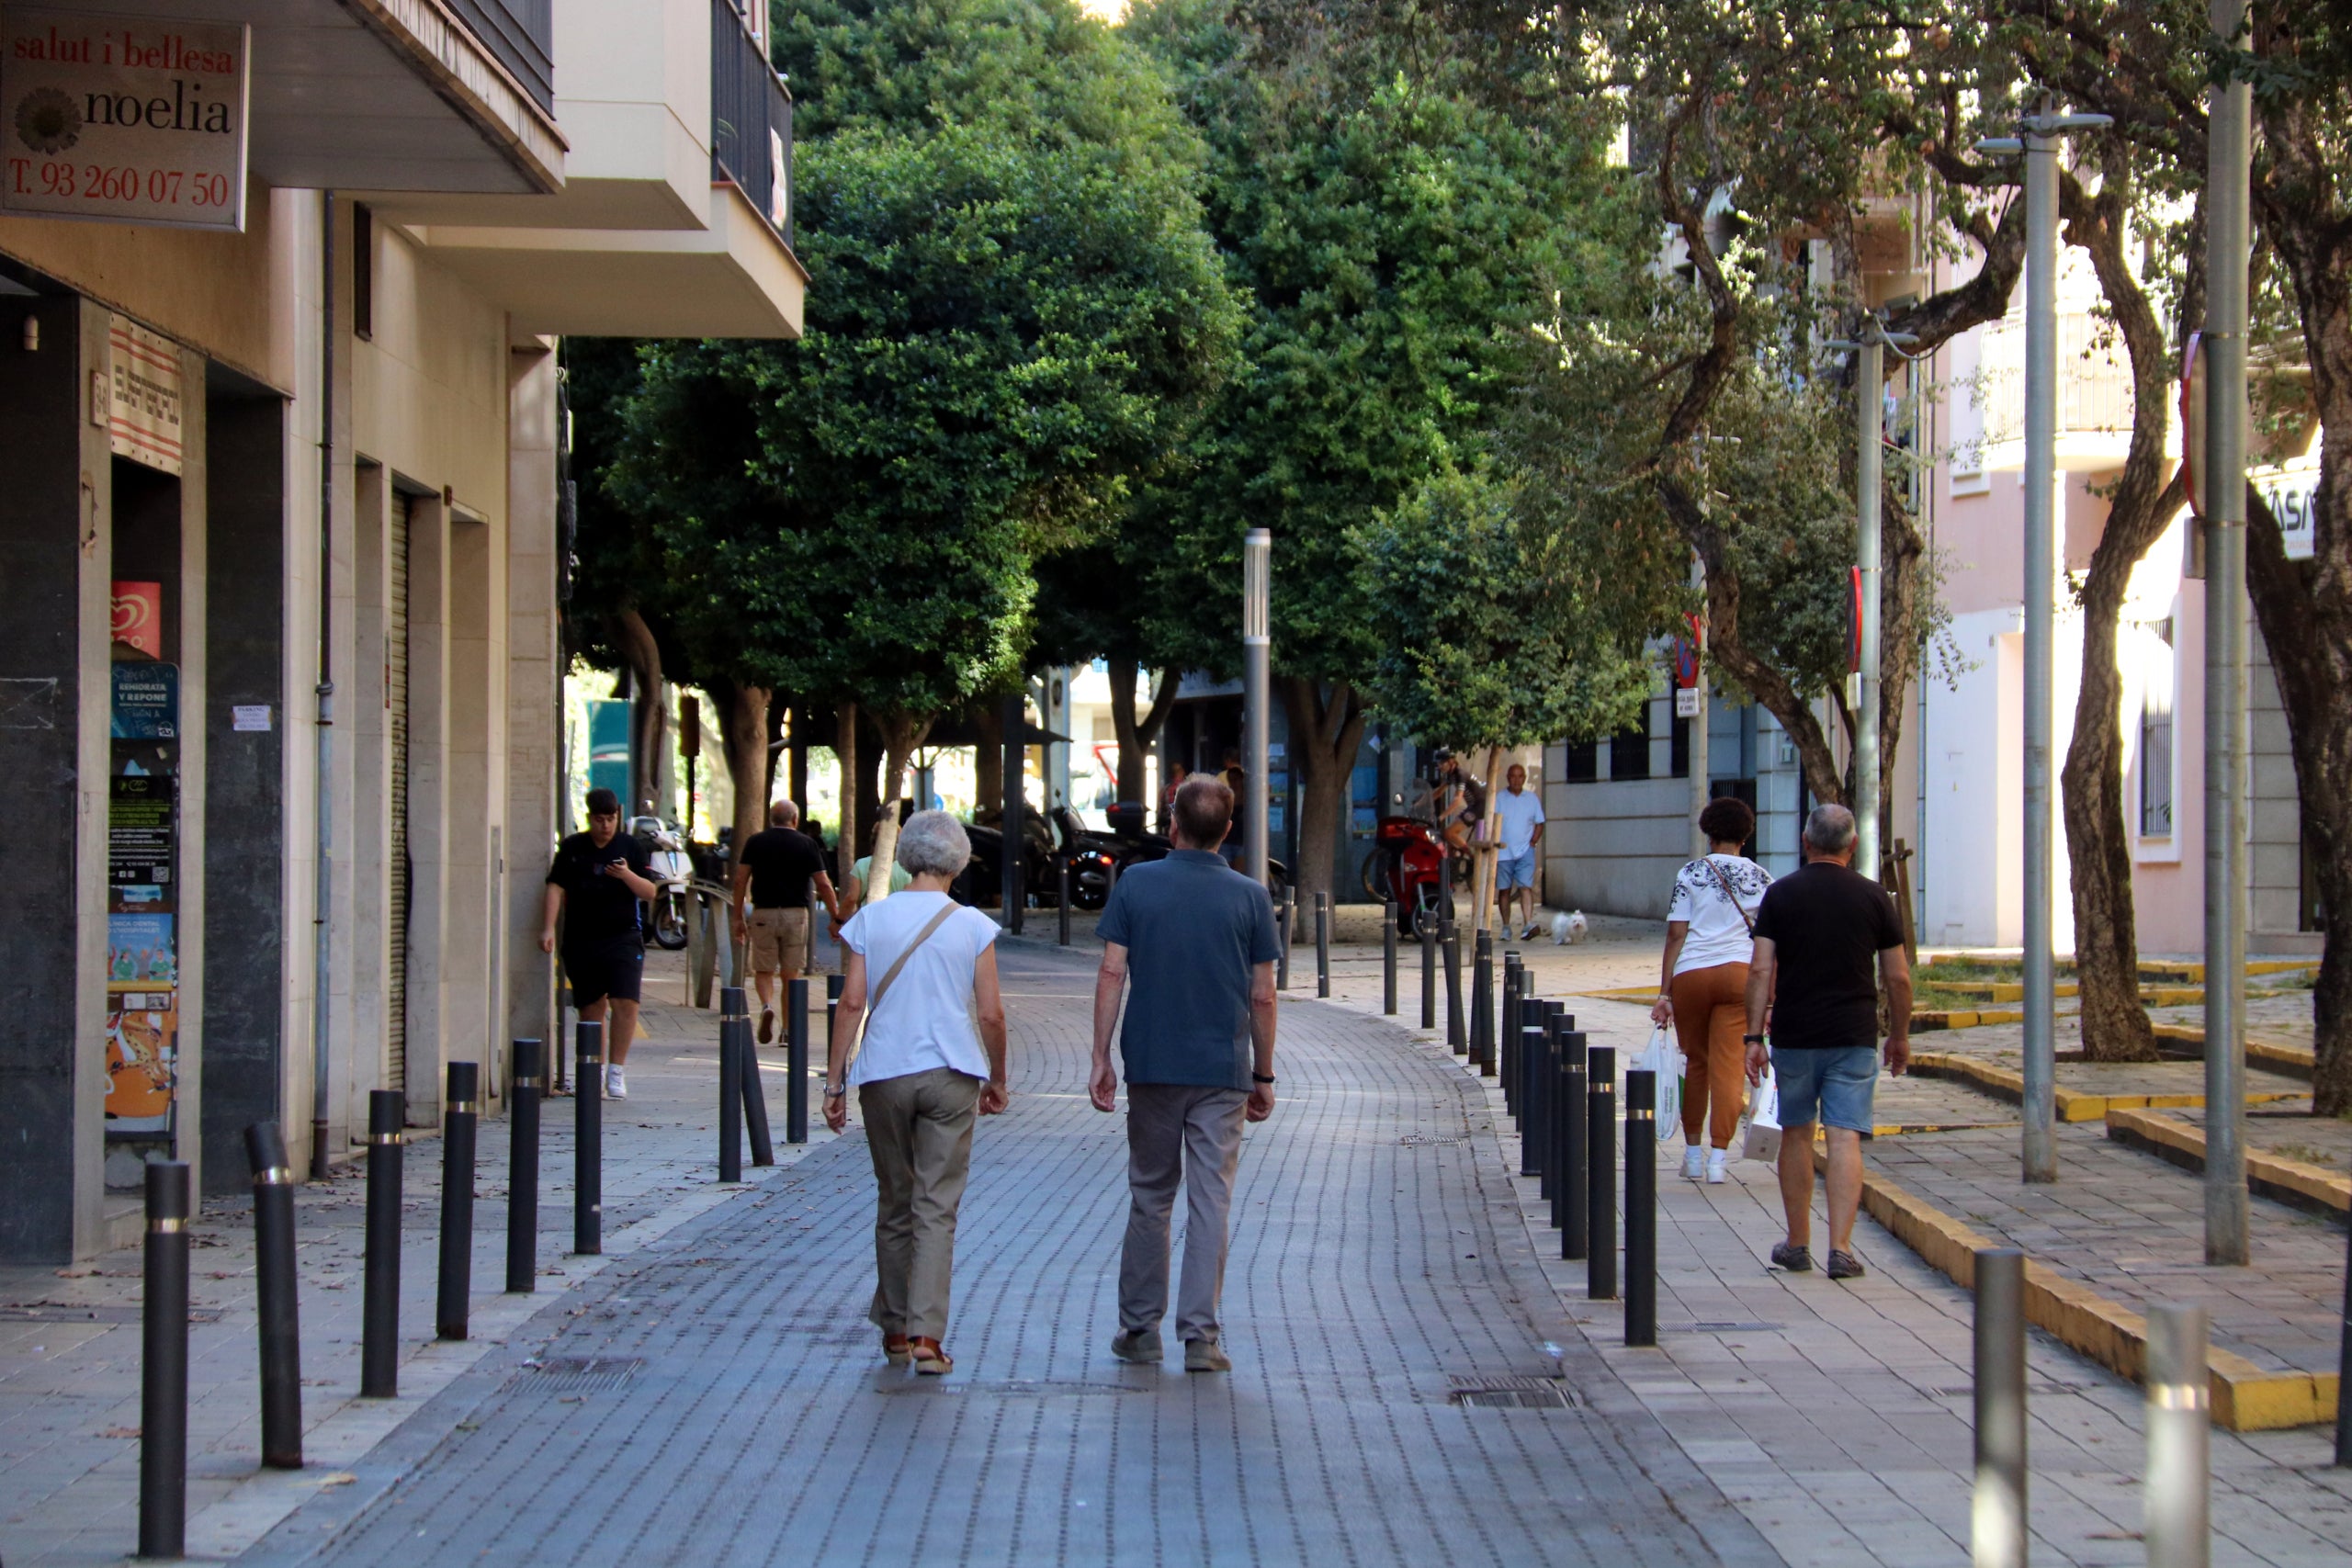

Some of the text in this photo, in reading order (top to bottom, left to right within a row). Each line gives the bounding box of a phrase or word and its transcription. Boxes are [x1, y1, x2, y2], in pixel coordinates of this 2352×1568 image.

[14, 27, 233, 73] salut i bellesa
[84, 79, 232, 133] noelia
[10, 158, 228, 207] T. 93 260 07 50
[119, 693, 167, 702] Y REPONE
